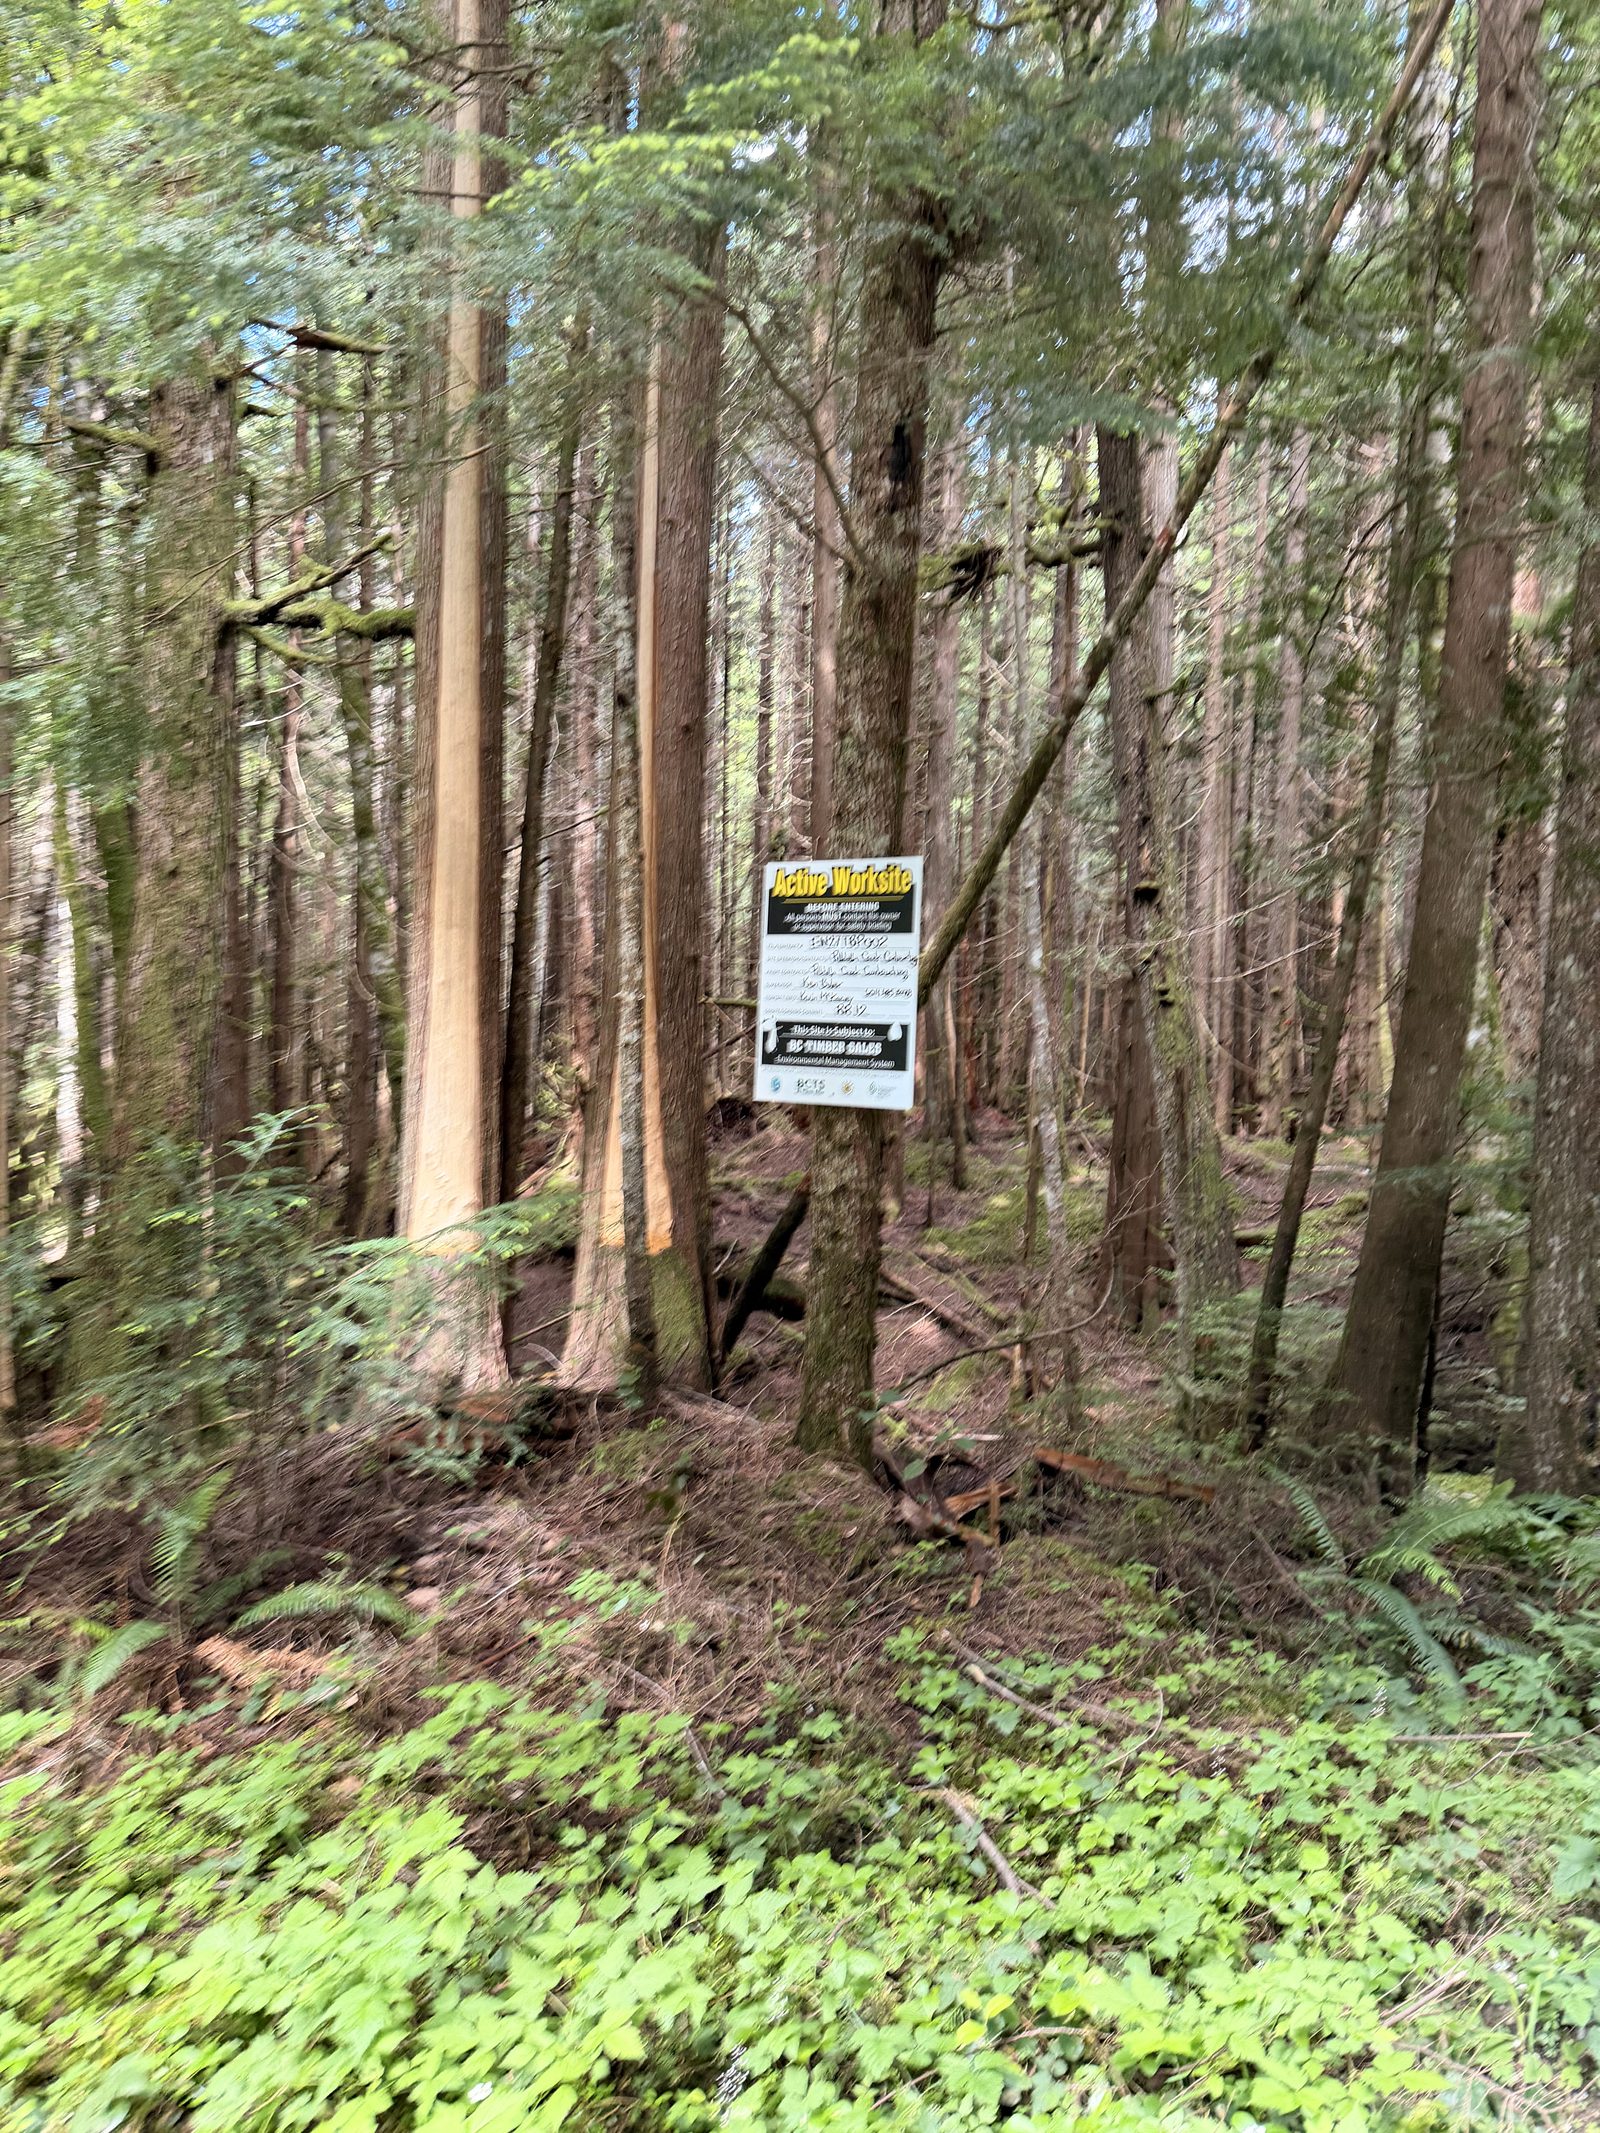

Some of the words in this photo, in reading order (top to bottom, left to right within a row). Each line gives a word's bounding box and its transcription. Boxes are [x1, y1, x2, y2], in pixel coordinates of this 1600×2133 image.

[771, 867, 828, 897] Active
[832, 864, 913, 897] Worksite
[804, 903, 838, 914] BEFORE
[790, 1024, 809, 1036] This
[786, 1039, 804, 1053] BC
[804, 1040, 846, 1054] TIMBER
[845, 1041, 883, 1056] SALES
[775, 1053, 825, 1065] Environmental
[824, 1055, 869, 1069] Management
